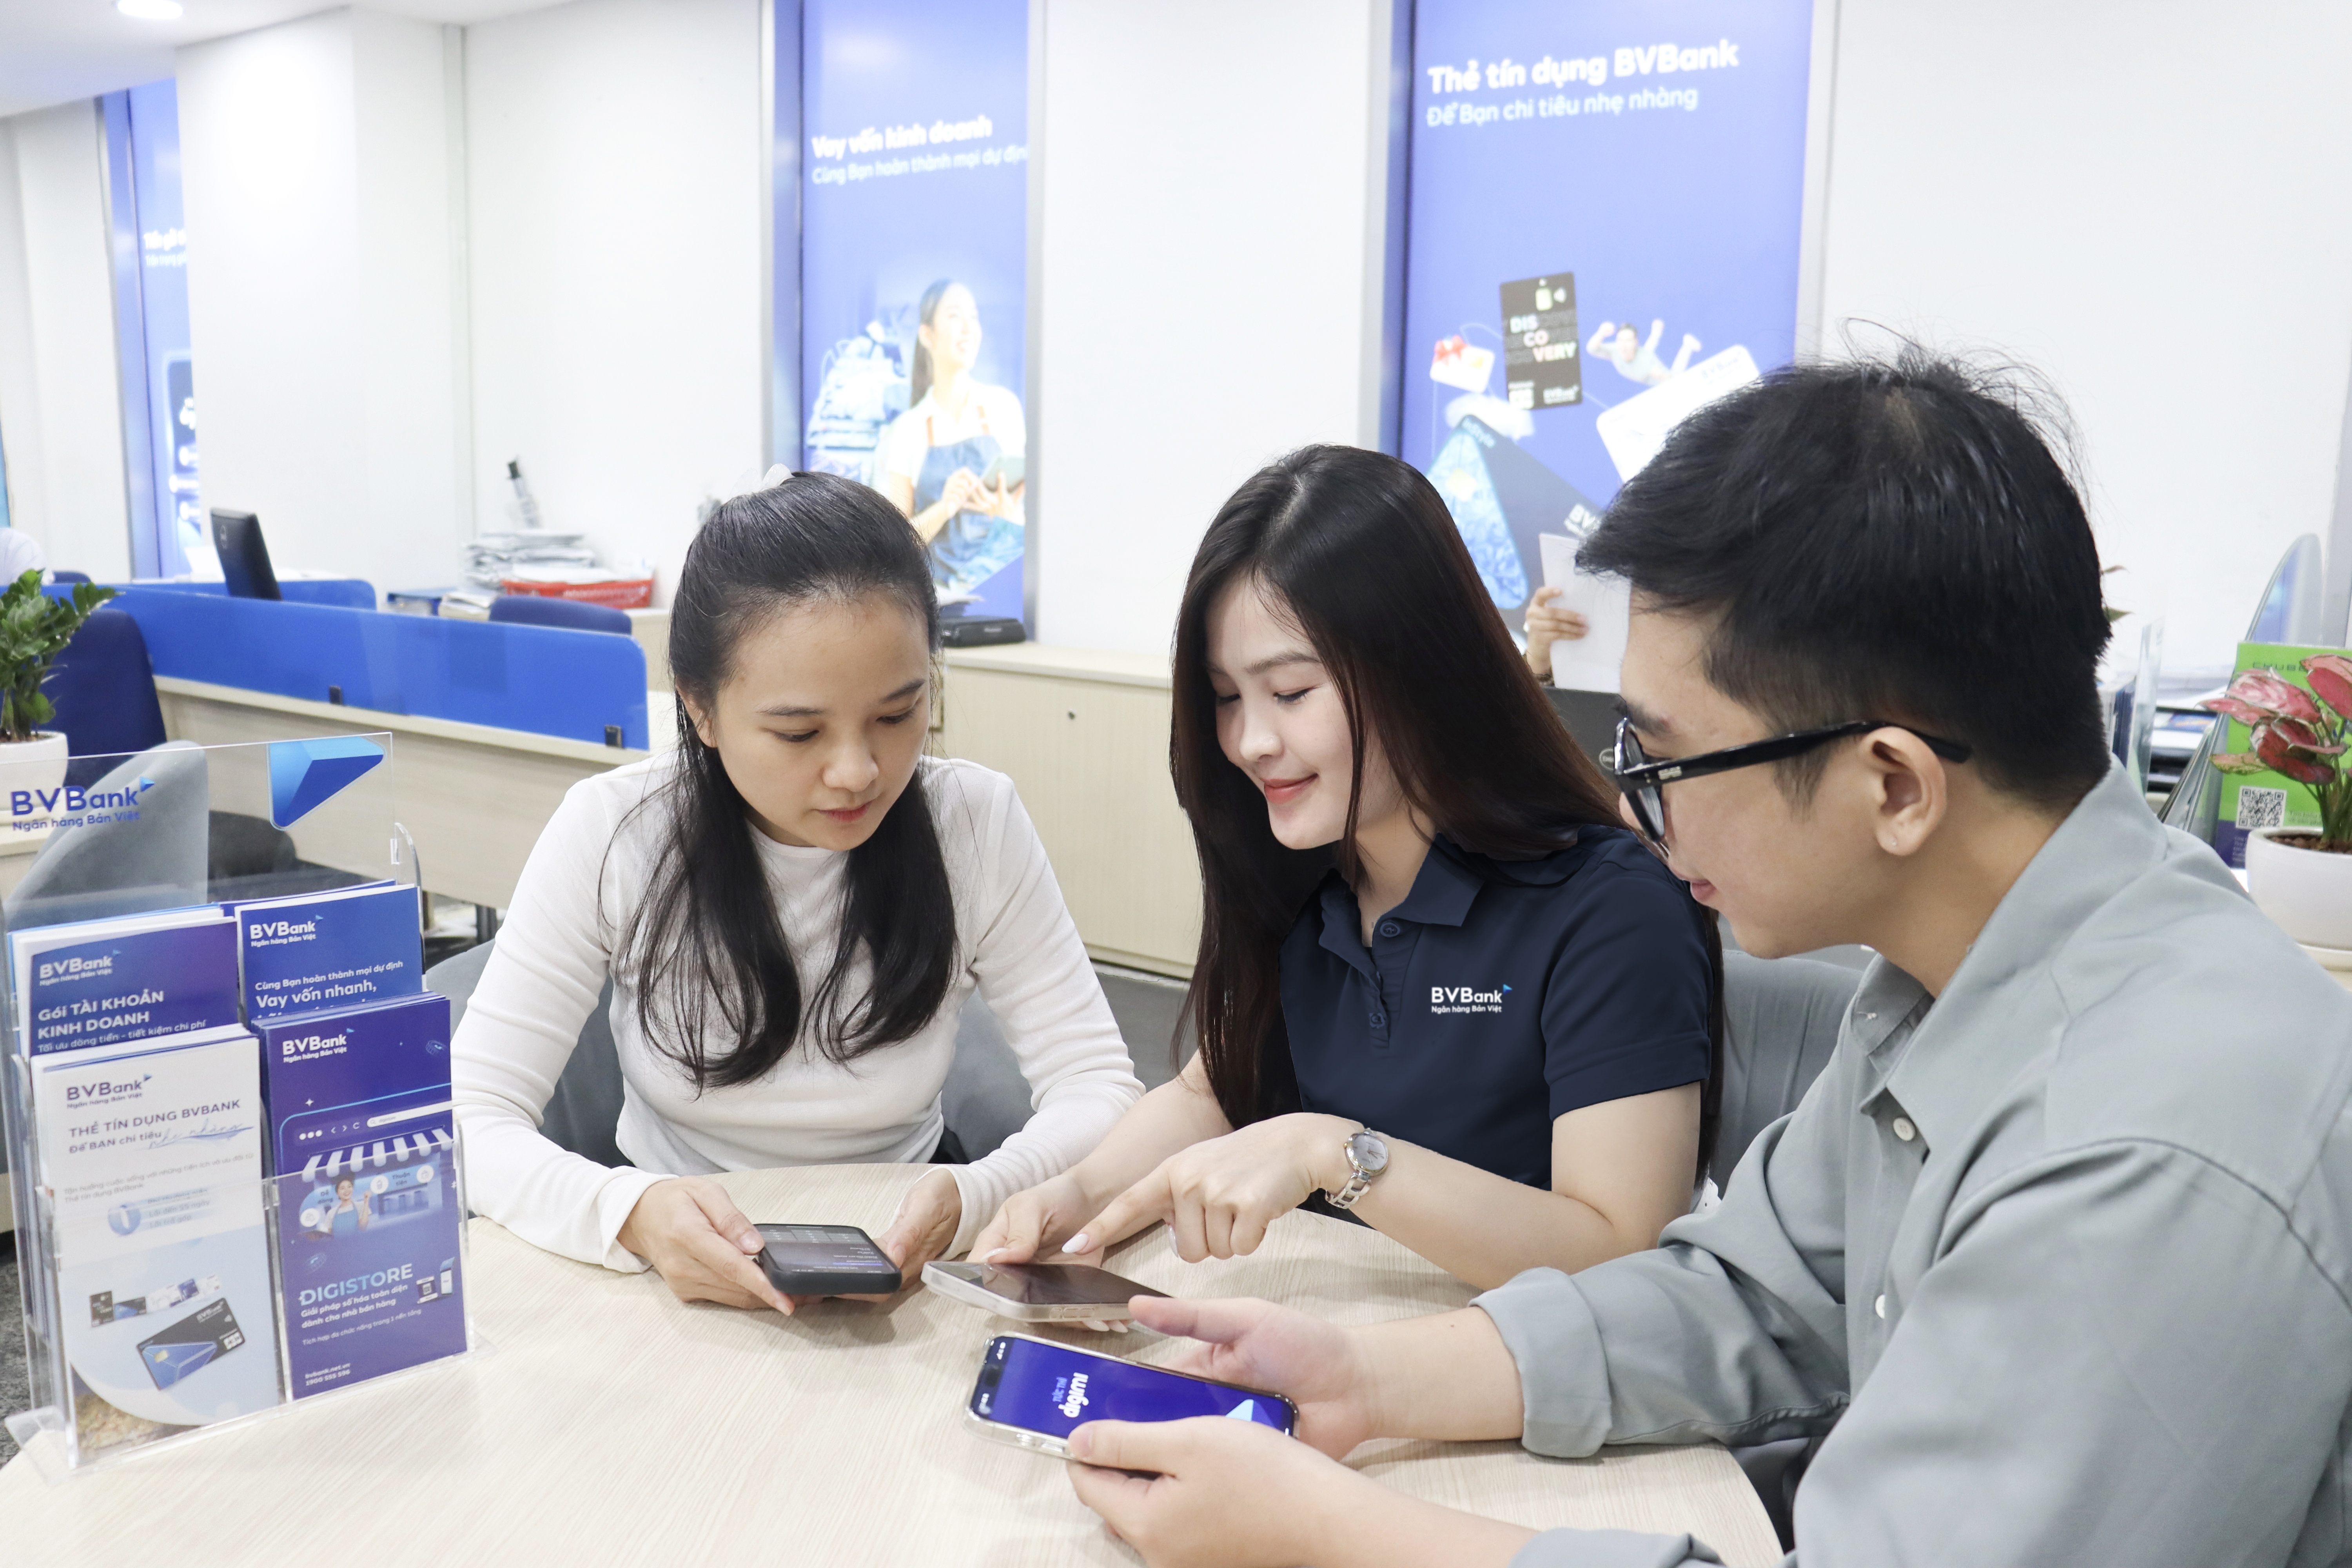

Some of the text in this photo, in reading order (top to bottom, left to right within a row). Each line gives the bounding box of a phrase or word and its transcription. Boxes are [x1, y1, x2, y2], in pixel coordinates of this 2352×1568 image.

[1427, 38, 1739, 94] Thẻ tín dụng BVBank
[1427, 86, 1698, 127] Để Bạn chi tiêu nhẹ nhàng
[811, 115, 993, 161] Vay vốn kinh doanh
[812, 166, 846, 185] Cùng
[848, 163, 874, 181] Bạn
[875, 158, 909, 176] hoàn
[911, 154, 953, 173] thành
[954, 150, 980, 169] mọi
[11, 785, 138, 816] BVBank
[13, 810, 140, 832] Ngân hàng Bản Việt
[250, 920, 316, 940] BVBank
[250, 939, 270, 947] Ngân
[40, 955, 113, 979] BVBank
[255, 960, 403, 991] Cùng Bạn hoàn thành mọi dự định
[38, 988, 165, 1021] Gói TÀI KHOẢN
[256, 979, 377, 1009] Vay vốn nhanh,
[1432, 987, 1502, 1003] BVBank
[1432, 1005, 1450, 1014] Ngân
[38, 1011, 150, 1040] KINH DOANH
[56, 1040, 68, 1050] ưu
[99, 1032, 118, 1043] tiền
[128, 1028, 146, 1039] tiết
[149, 1025, 171, 1036] kiệm
[174, 1022, 189, 1032] chi
[191, 1019, 207, 1031] phí
[283, 1034, 347, 1055] BVBank
[283, 1055, 301, 1063] Ngân
[67, 1080, 142, 1101] BVBank
[69, 1099, 241, 1138] THẺ TÍN DỤNG BVBANK
[89, 1139, 115, 1151] BẠN
[119, 1134, 136, 1145] chi
[140, 1131, 161, 1142] tiêu
[300, 1263, 414, 1306] DIGISTORE
[301, 1284, 408, 1318] Giải pháp số hóa toàn diện
[301, 1299, 397, 1328] dành cho nhà bán hàng
